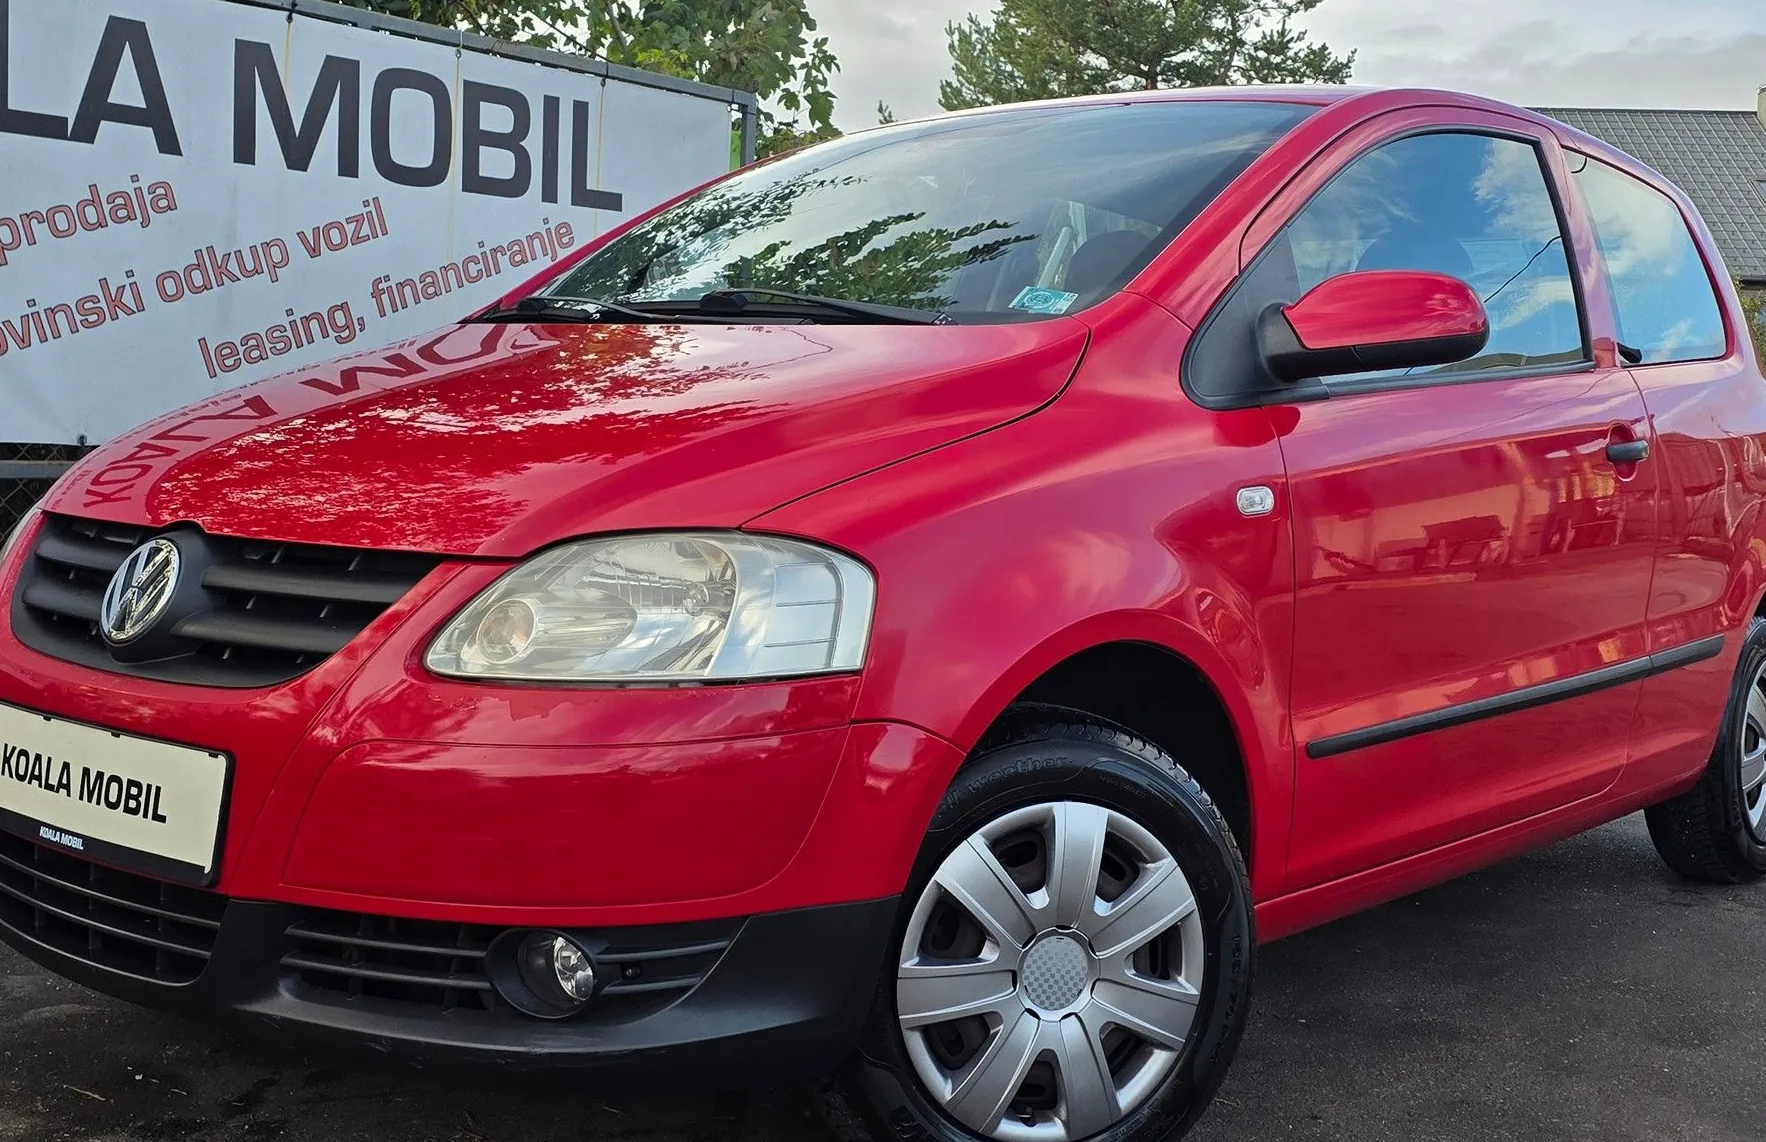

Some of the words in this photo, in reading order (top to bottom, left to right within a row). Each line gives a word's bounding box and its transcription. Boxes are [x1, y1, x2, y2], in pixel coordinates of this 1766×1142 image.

[233, 39, 623, 211] MOBIL
[0, 174, 178, 266] prodaja
[156, 245, 290, 302] odkup
[297, 197, 389, 258] vozil
[198, 301, 366, 378] leasing,
[371, 217, 575, 318] financiranje
[1, 743, 71, 797] KOALA
[78, 766, 167, 823] MOBIL
[40, 825, 60, 843] KOALA
[60, 833, 84, 850] MOBIL
